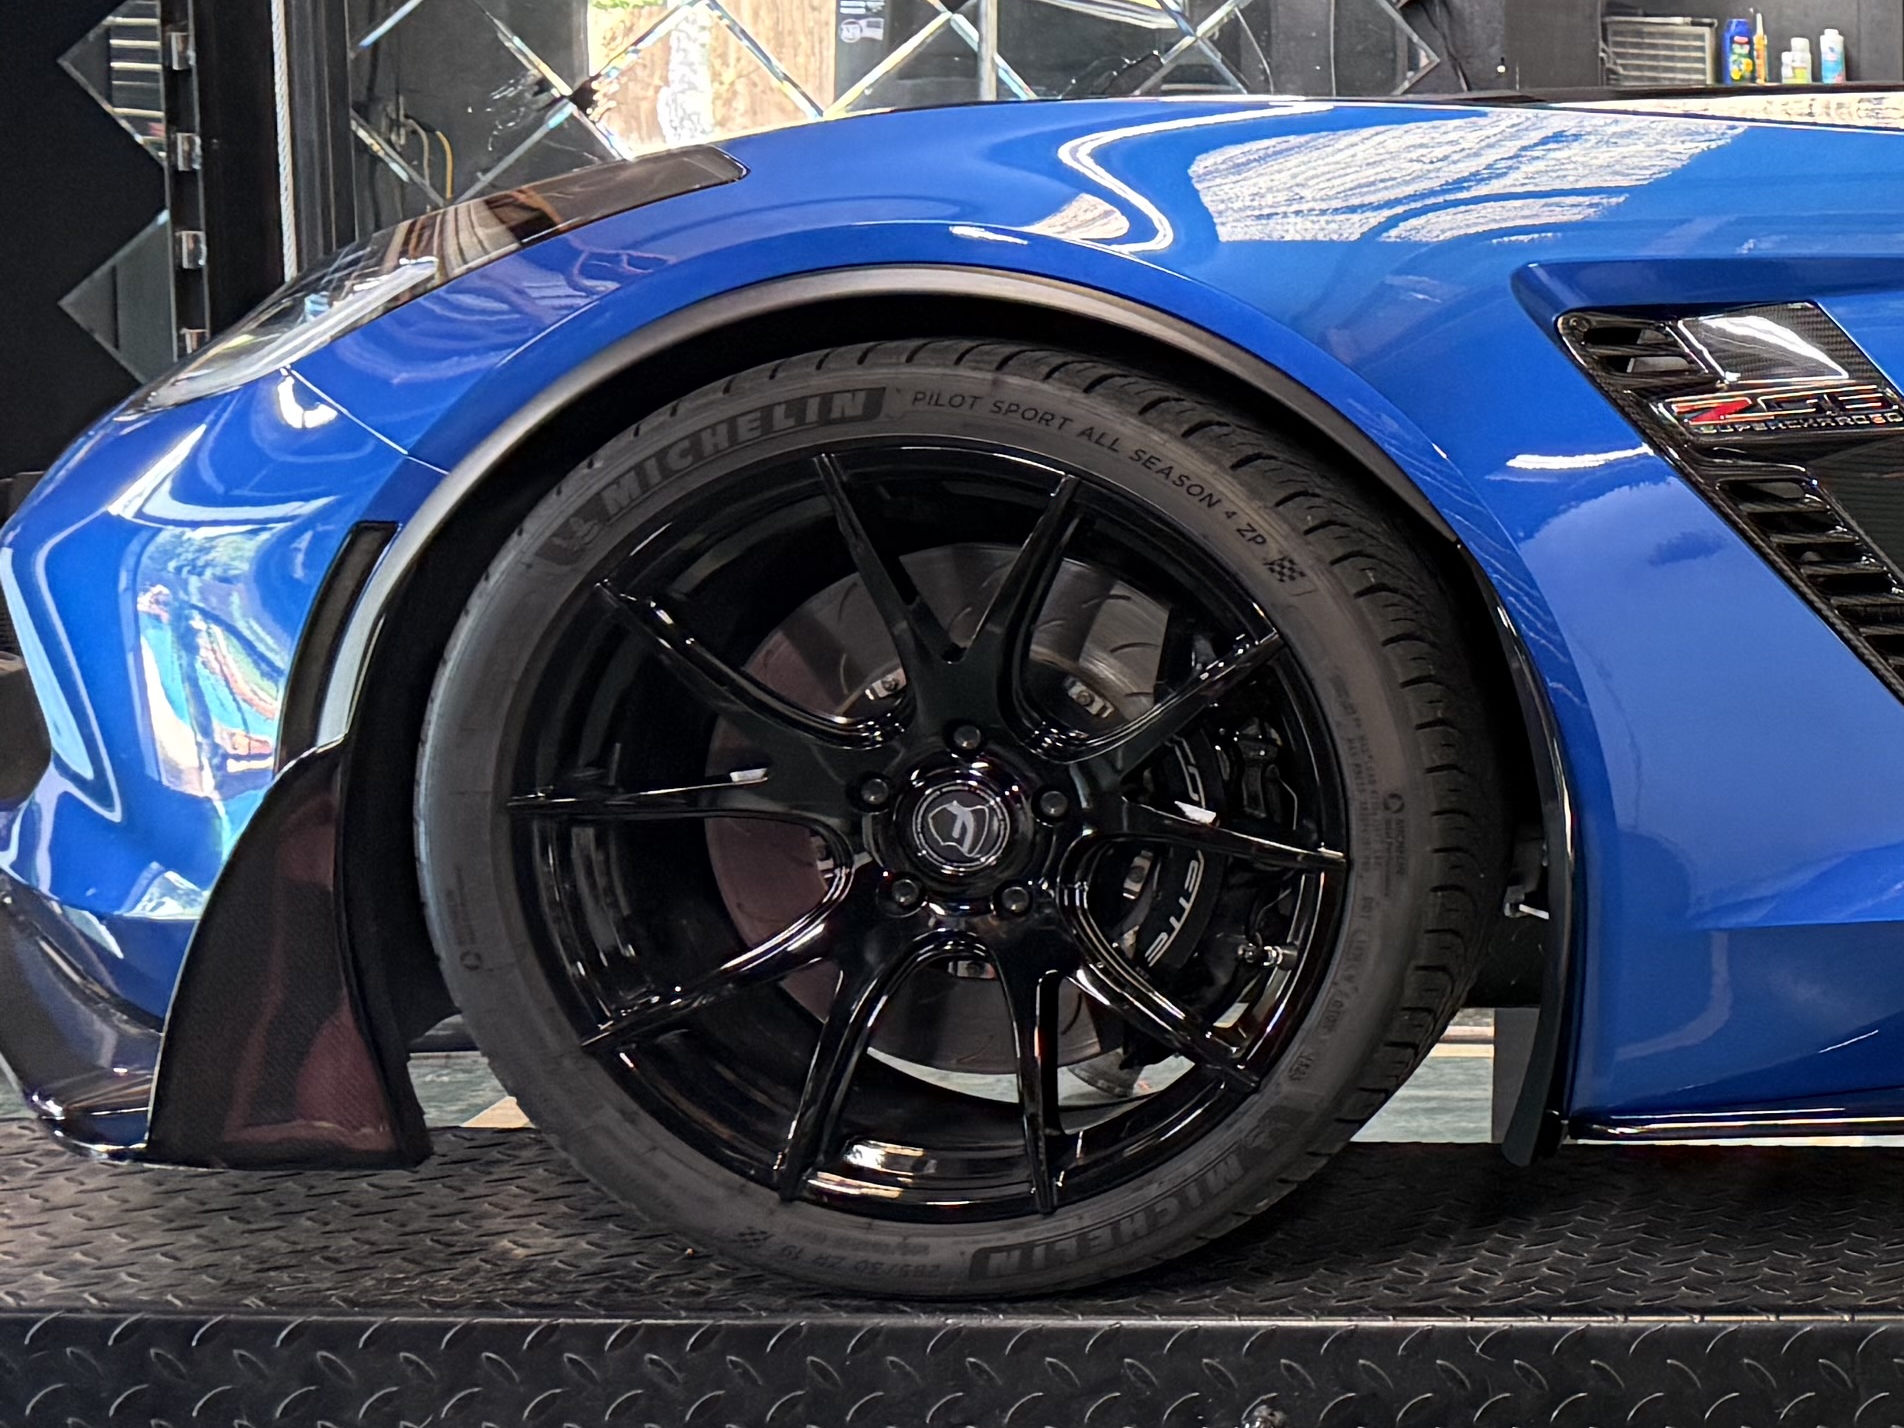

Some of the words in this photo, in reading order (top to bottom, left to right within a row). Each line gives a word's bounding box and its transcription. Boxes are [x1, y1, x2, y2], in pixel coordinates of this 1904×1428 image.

[601, 389, 868, 513] MICHELIN
[912, 390, 983, 409] PILOT
[989, 399, 1074, 432] SPORT
[1077, 425, 1121, 454] ALL
[1128, 448, 1223, 510] SEASON
[1223, 509, 1235, 521] 4
[1236, 522, 1268, 548] ZP
[1699, 411, 1904, 435] SUPERCHARGED
[986, 1150, 1246, 1273] MICHELIN
